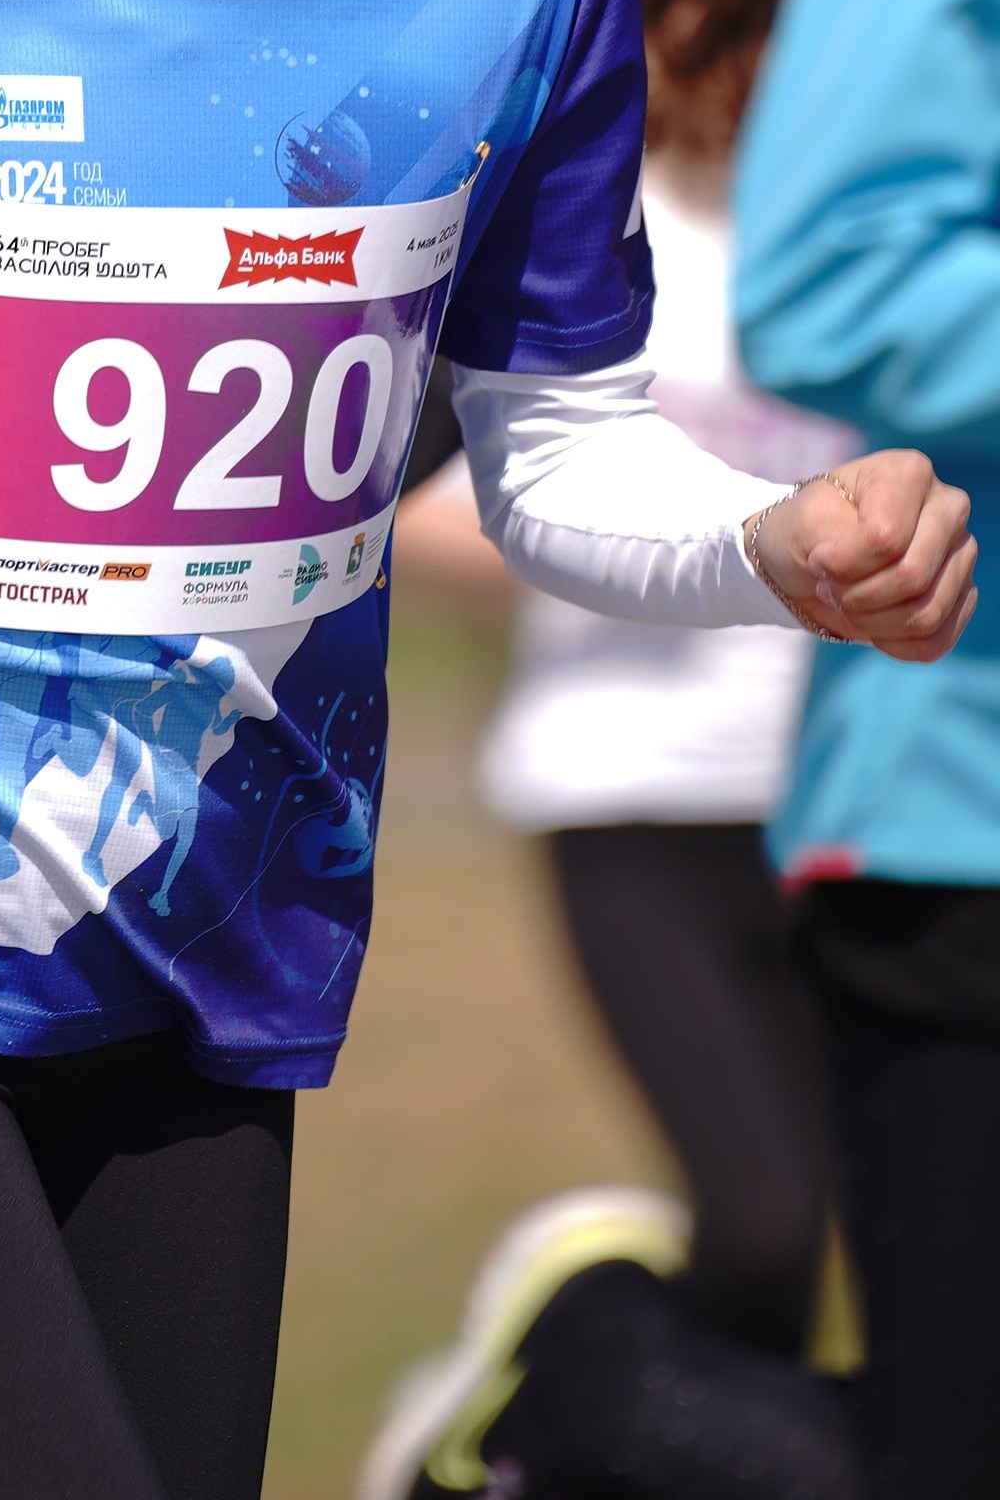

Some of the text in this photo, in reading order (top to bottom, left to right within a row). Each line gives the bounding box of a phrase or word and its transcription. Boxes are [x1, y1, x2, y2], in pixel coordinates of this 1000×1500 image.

[9, 100, 65, 114] ГАЗПРОМ
[32, 239, 111, 258] ПРОБЕГ
[406, 238, 415, 253] 4
[238, 247, 346, 270] Альфа Банк
[50, 333, 394, 512] 920
[103, 565, 148, 579] PRO
[185, 560, 252, 577] СИБУР
[296, 561, 328, 577] РАДИО
[183, 580, 249, 595] ФОРМУЛА
